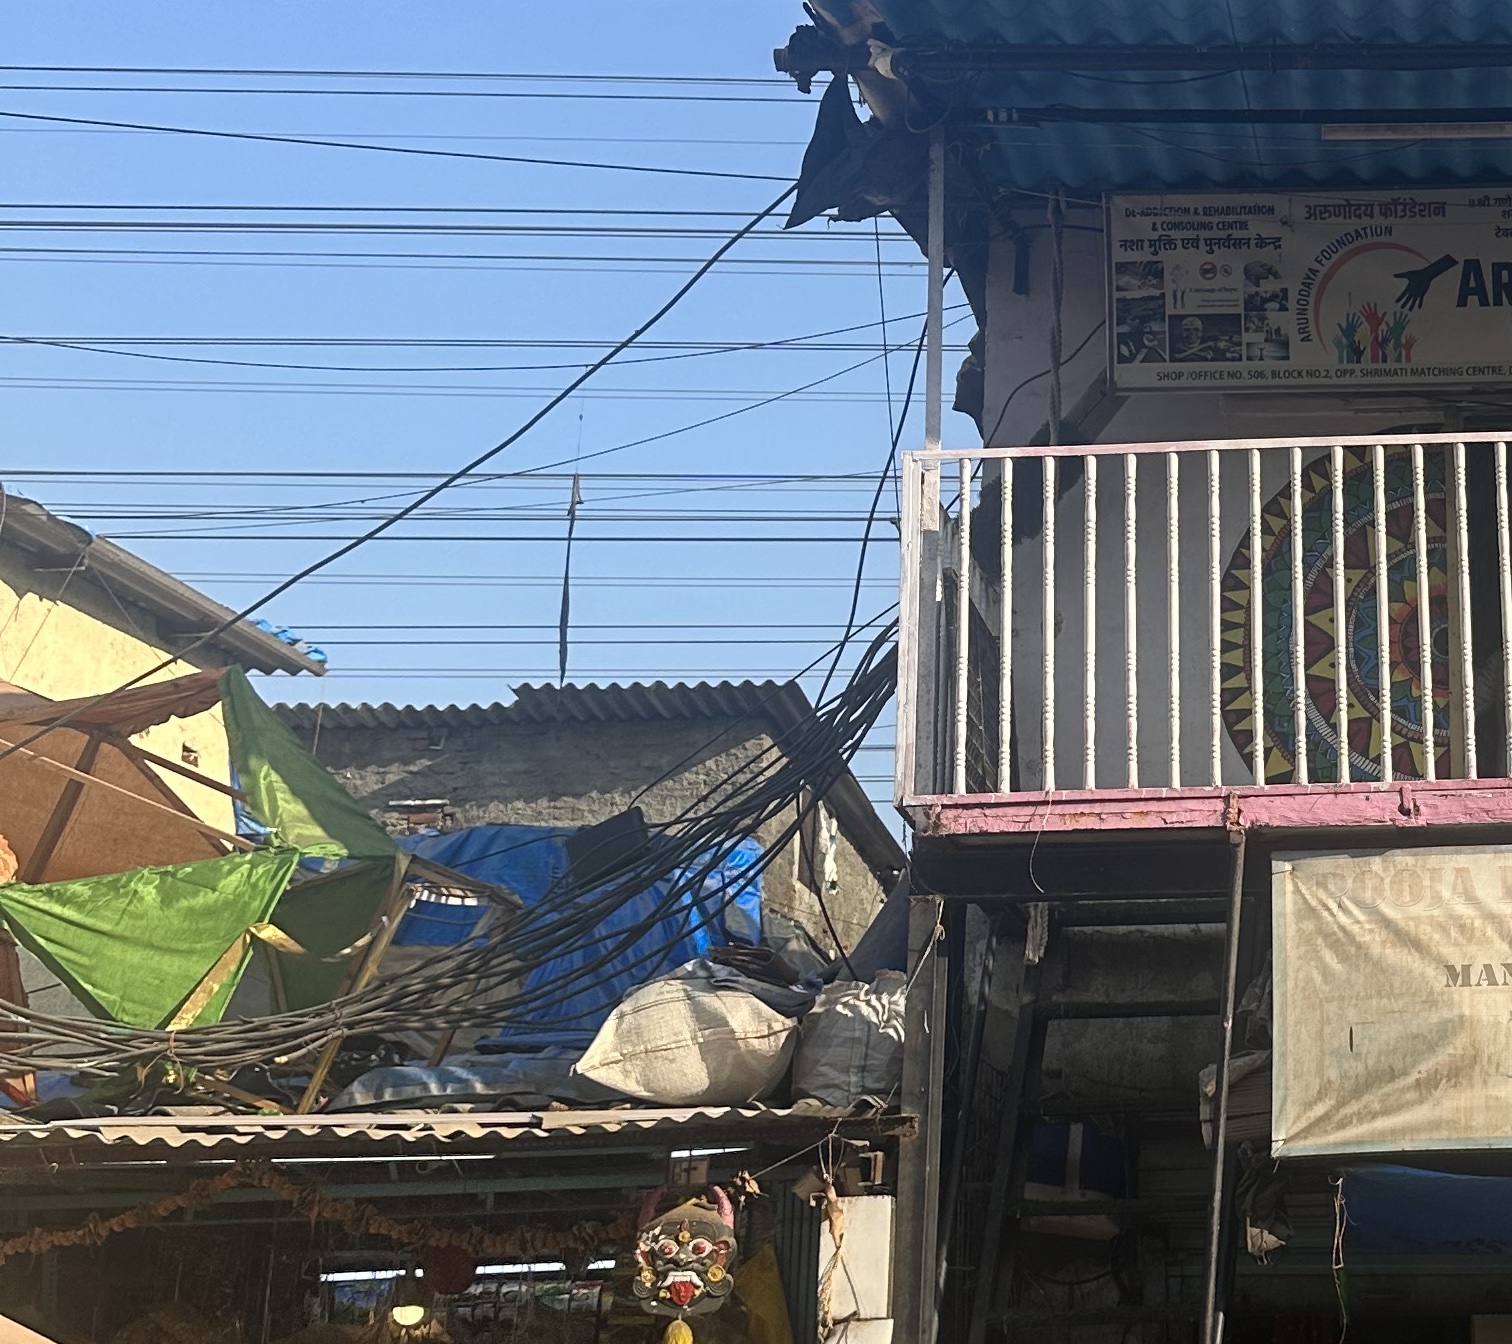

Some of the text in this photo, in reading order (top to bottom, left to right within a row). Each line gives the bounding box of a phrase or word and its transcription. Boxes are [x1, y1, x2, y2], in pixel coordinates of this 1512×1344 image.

[1304, 199, 1375, 222] अरुणोदय
[1151, 220, 1249, 232] & CONSOLING CENTRE
[1118, 233, 1283, 256] नशा मुक्ति एवं पुनर्वसन केन्द्र
[1295, 225, 1394, 343] ARUNODAYA FOUNDATION
[1156, 371, 1184, 382] SHOP
[1186, 370, 1225, 382] /OFFICE
[1227, 370, 1245, 381] NO.
[1248, 370, 1269, 383] 506,
[1271, 369, 1304, 380] BLOCK
[1306, 368, 1333, 381] NO.2,
[1335, 368, 1358, 379] OPP.
[1360, 367, 1409, 378] SHRIMATI
[1410, 366, 1464, 378] MATCHING
[1466, 365, 1507, 376] CENTRE,
[1311, 864, 1482, 912] POOJA
